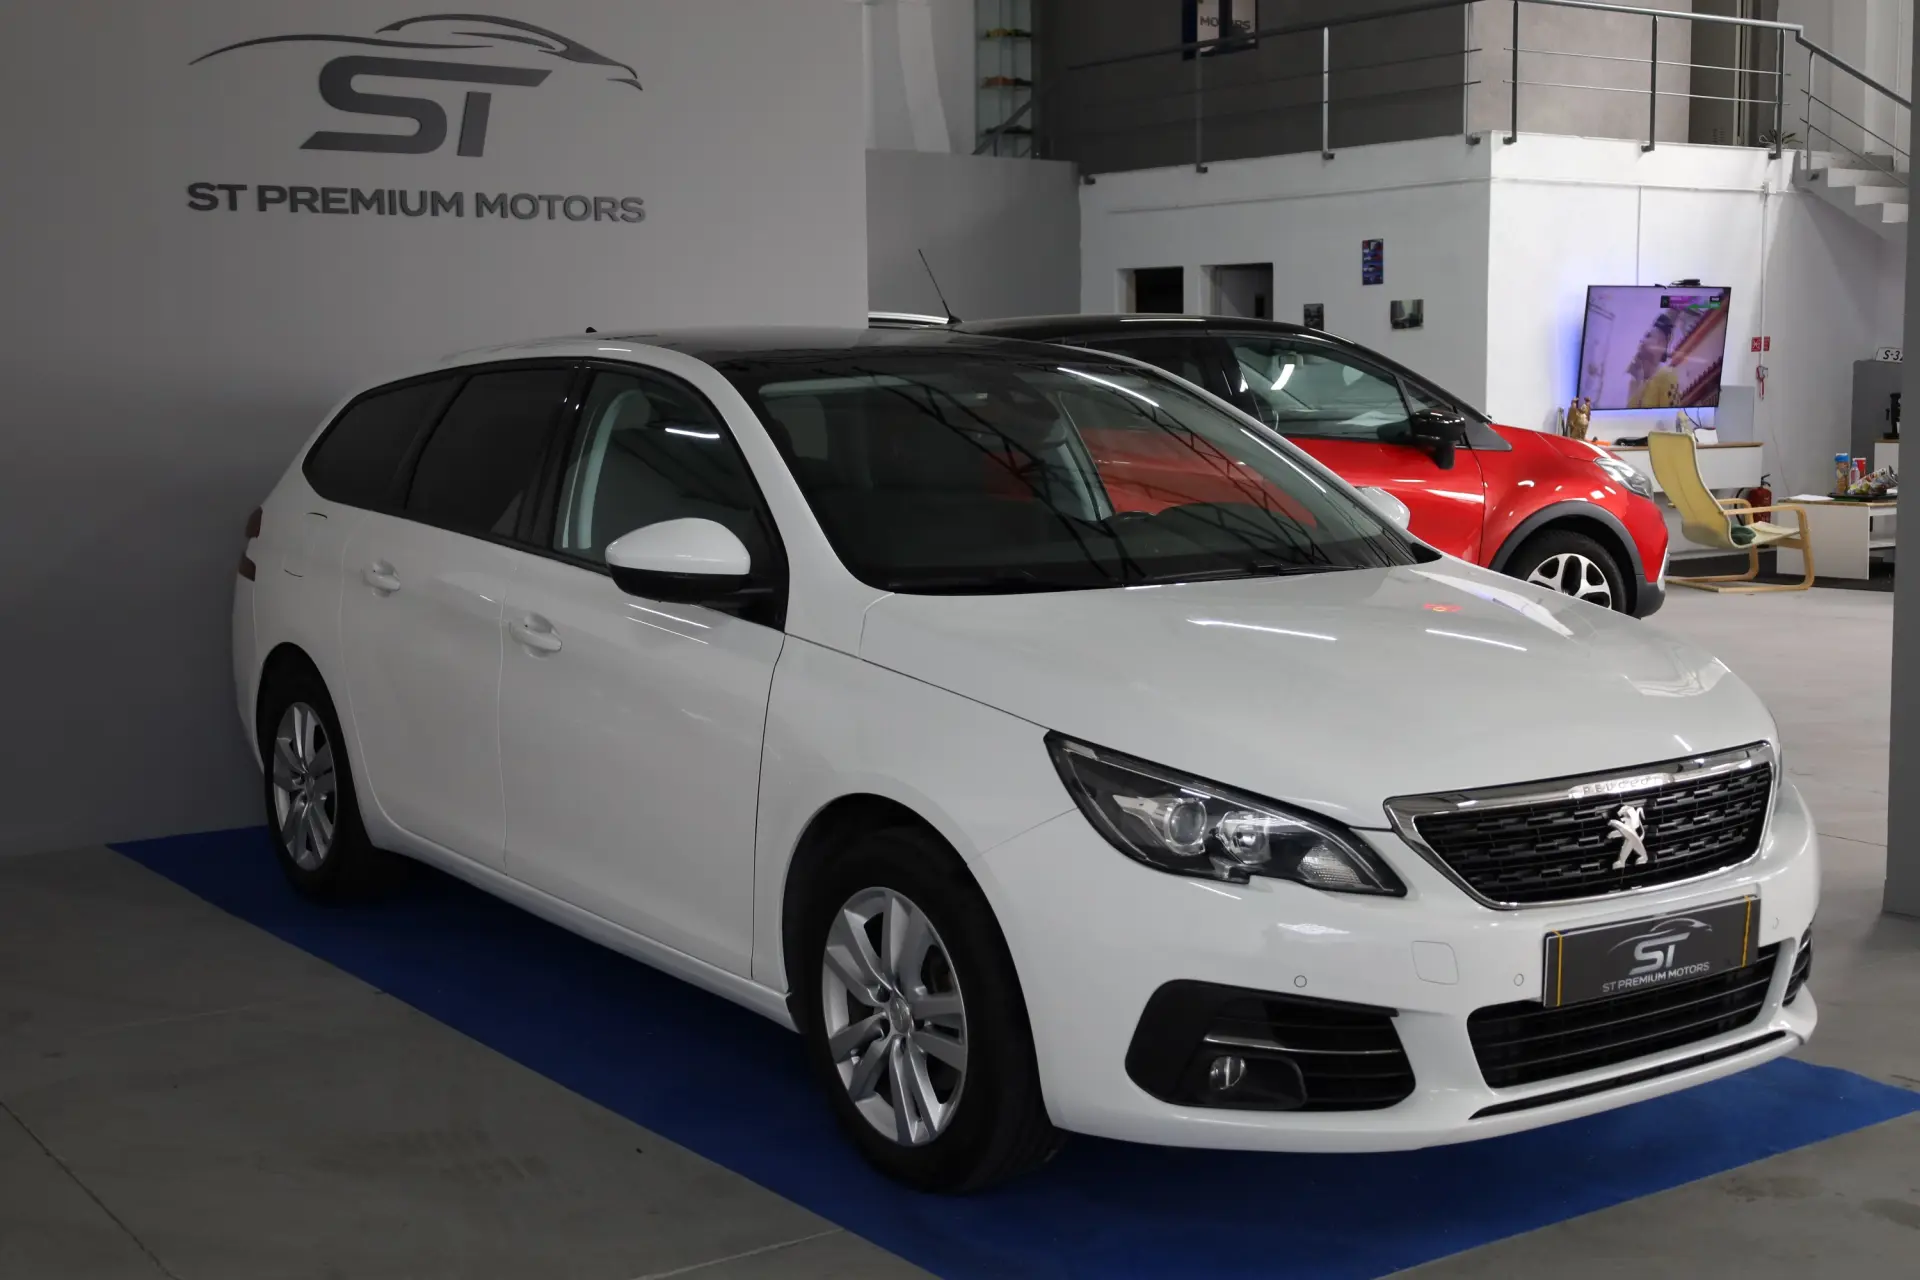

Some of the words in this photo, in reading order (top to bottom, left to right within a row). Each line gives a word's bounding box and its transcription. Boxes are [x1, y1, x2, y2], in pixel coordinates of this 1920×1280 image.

[1200, 16, 1251, 30] MORS
[299, 55, 553, 157] ST
[187, 182, 248, 212] ST
[257, 184, 464, 218] PREMIUM
[475, 192, 647, 223] MOTORS
[1629, 932, 1690, 975] ST
[1602, 981, 1616, 993] ST
[1618, 971, 1666, 990] PREMIUM
[1668, 961, 1710, 977] MOTORS
